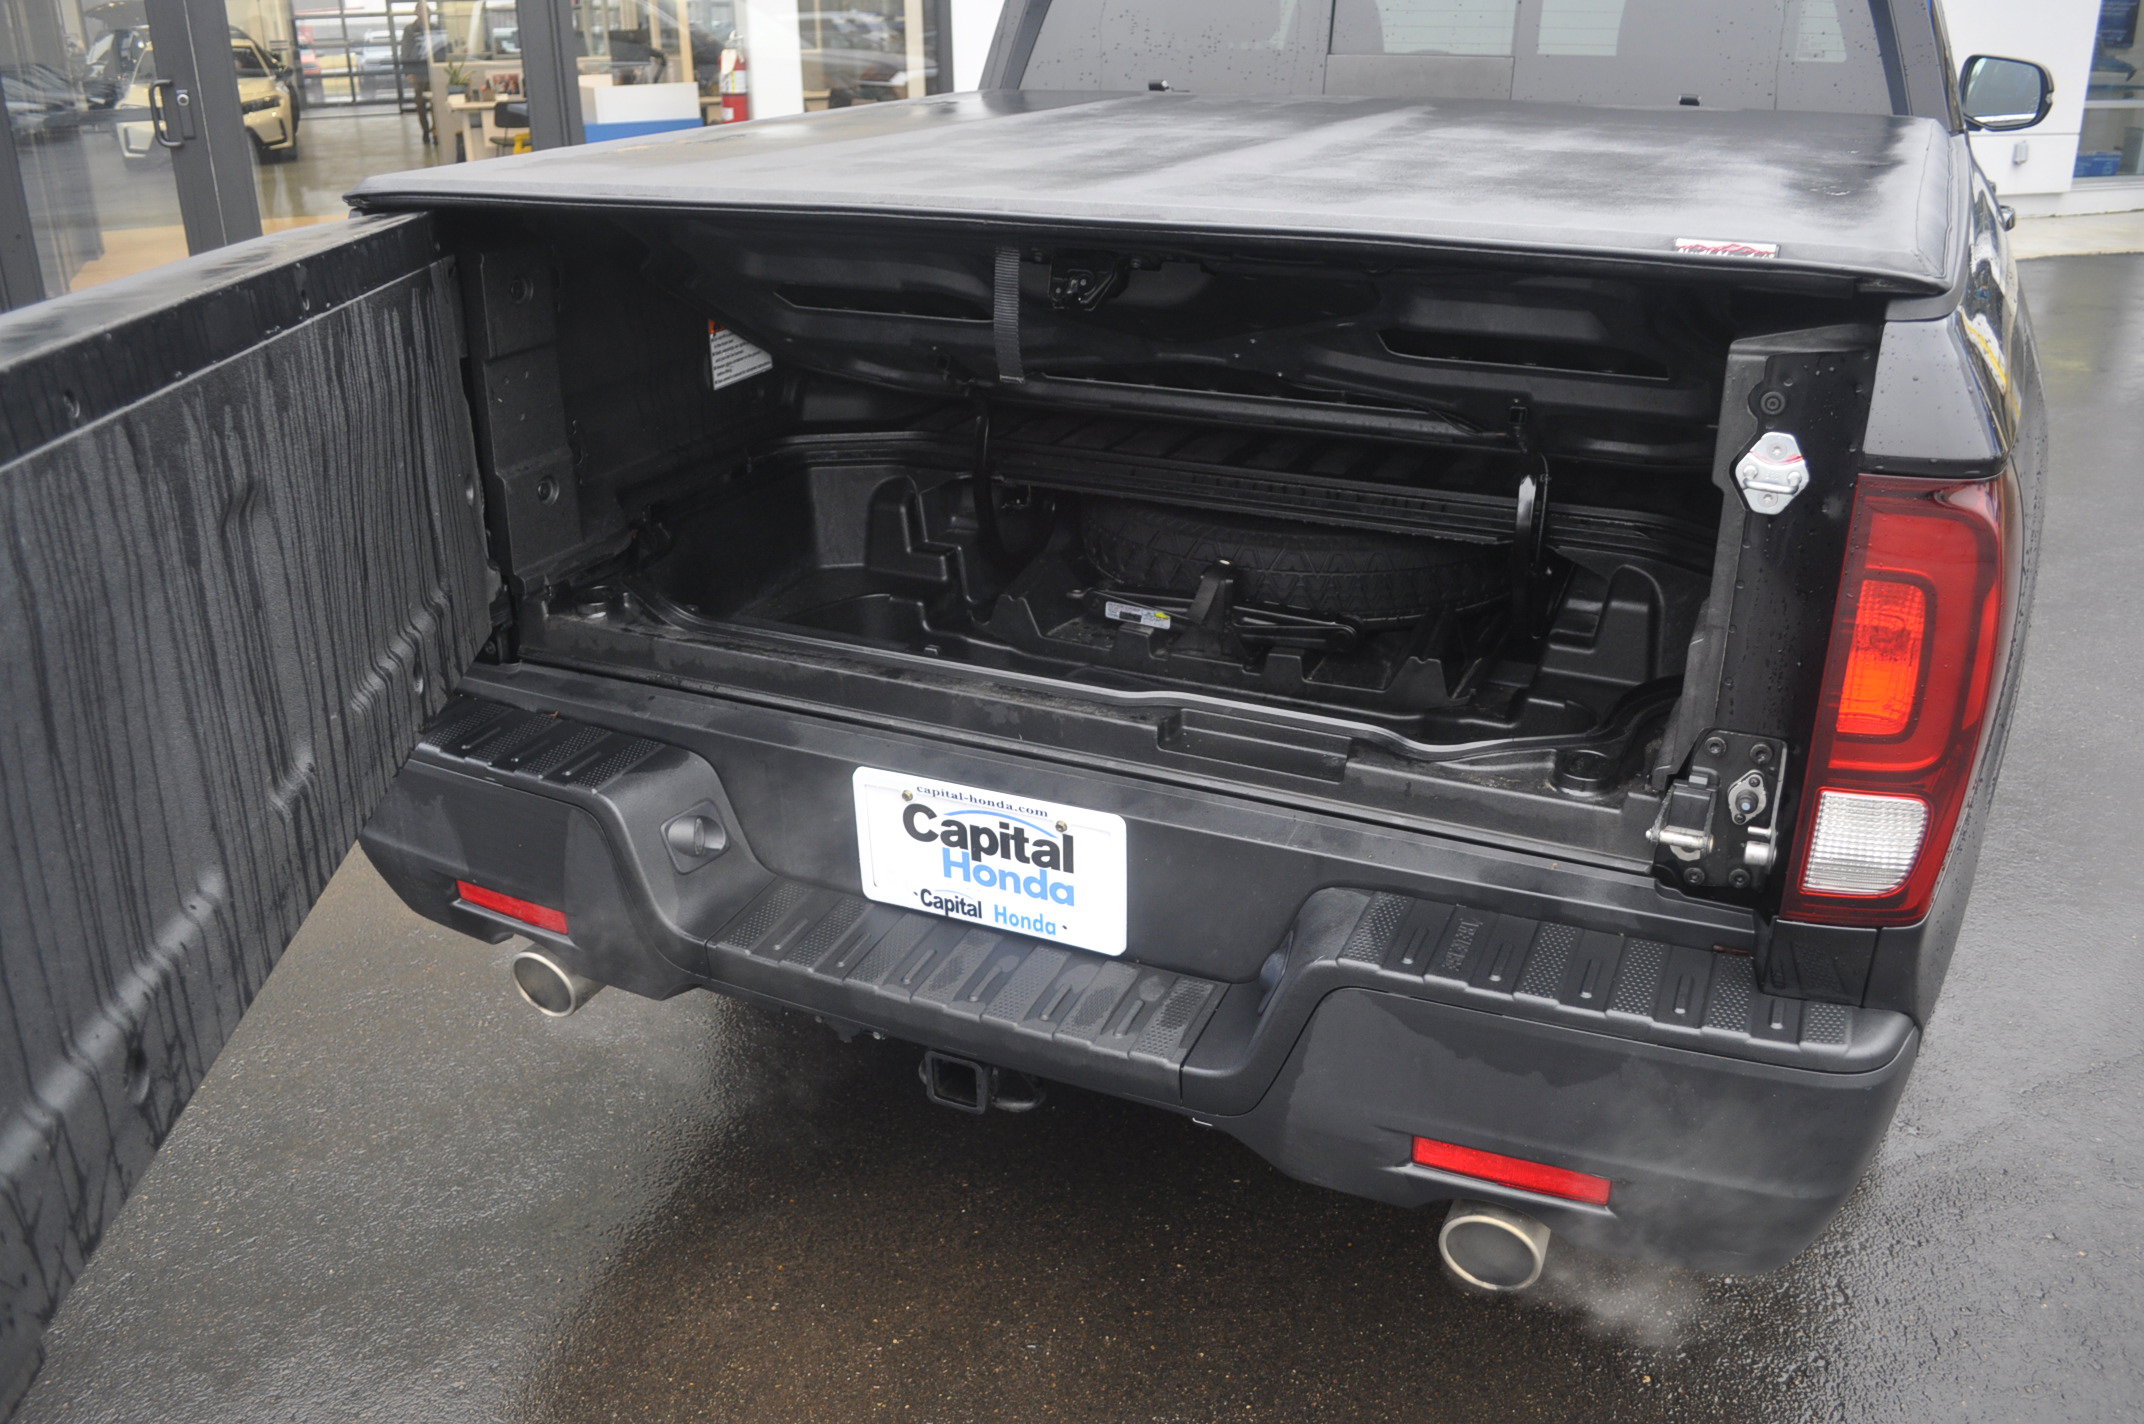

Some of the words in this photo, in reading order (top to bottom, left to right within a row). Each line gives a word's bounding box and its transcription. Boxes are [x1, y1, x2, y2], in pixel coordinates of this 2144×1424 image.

[916, 786, 1049, 818] capital-honda.com
[902, 803, 1075, 874] Capital
[942, 847, 1075, 907] Honda
[920, 888, 982, 919] Capital
[994, 904, 1056, 936] Honda
